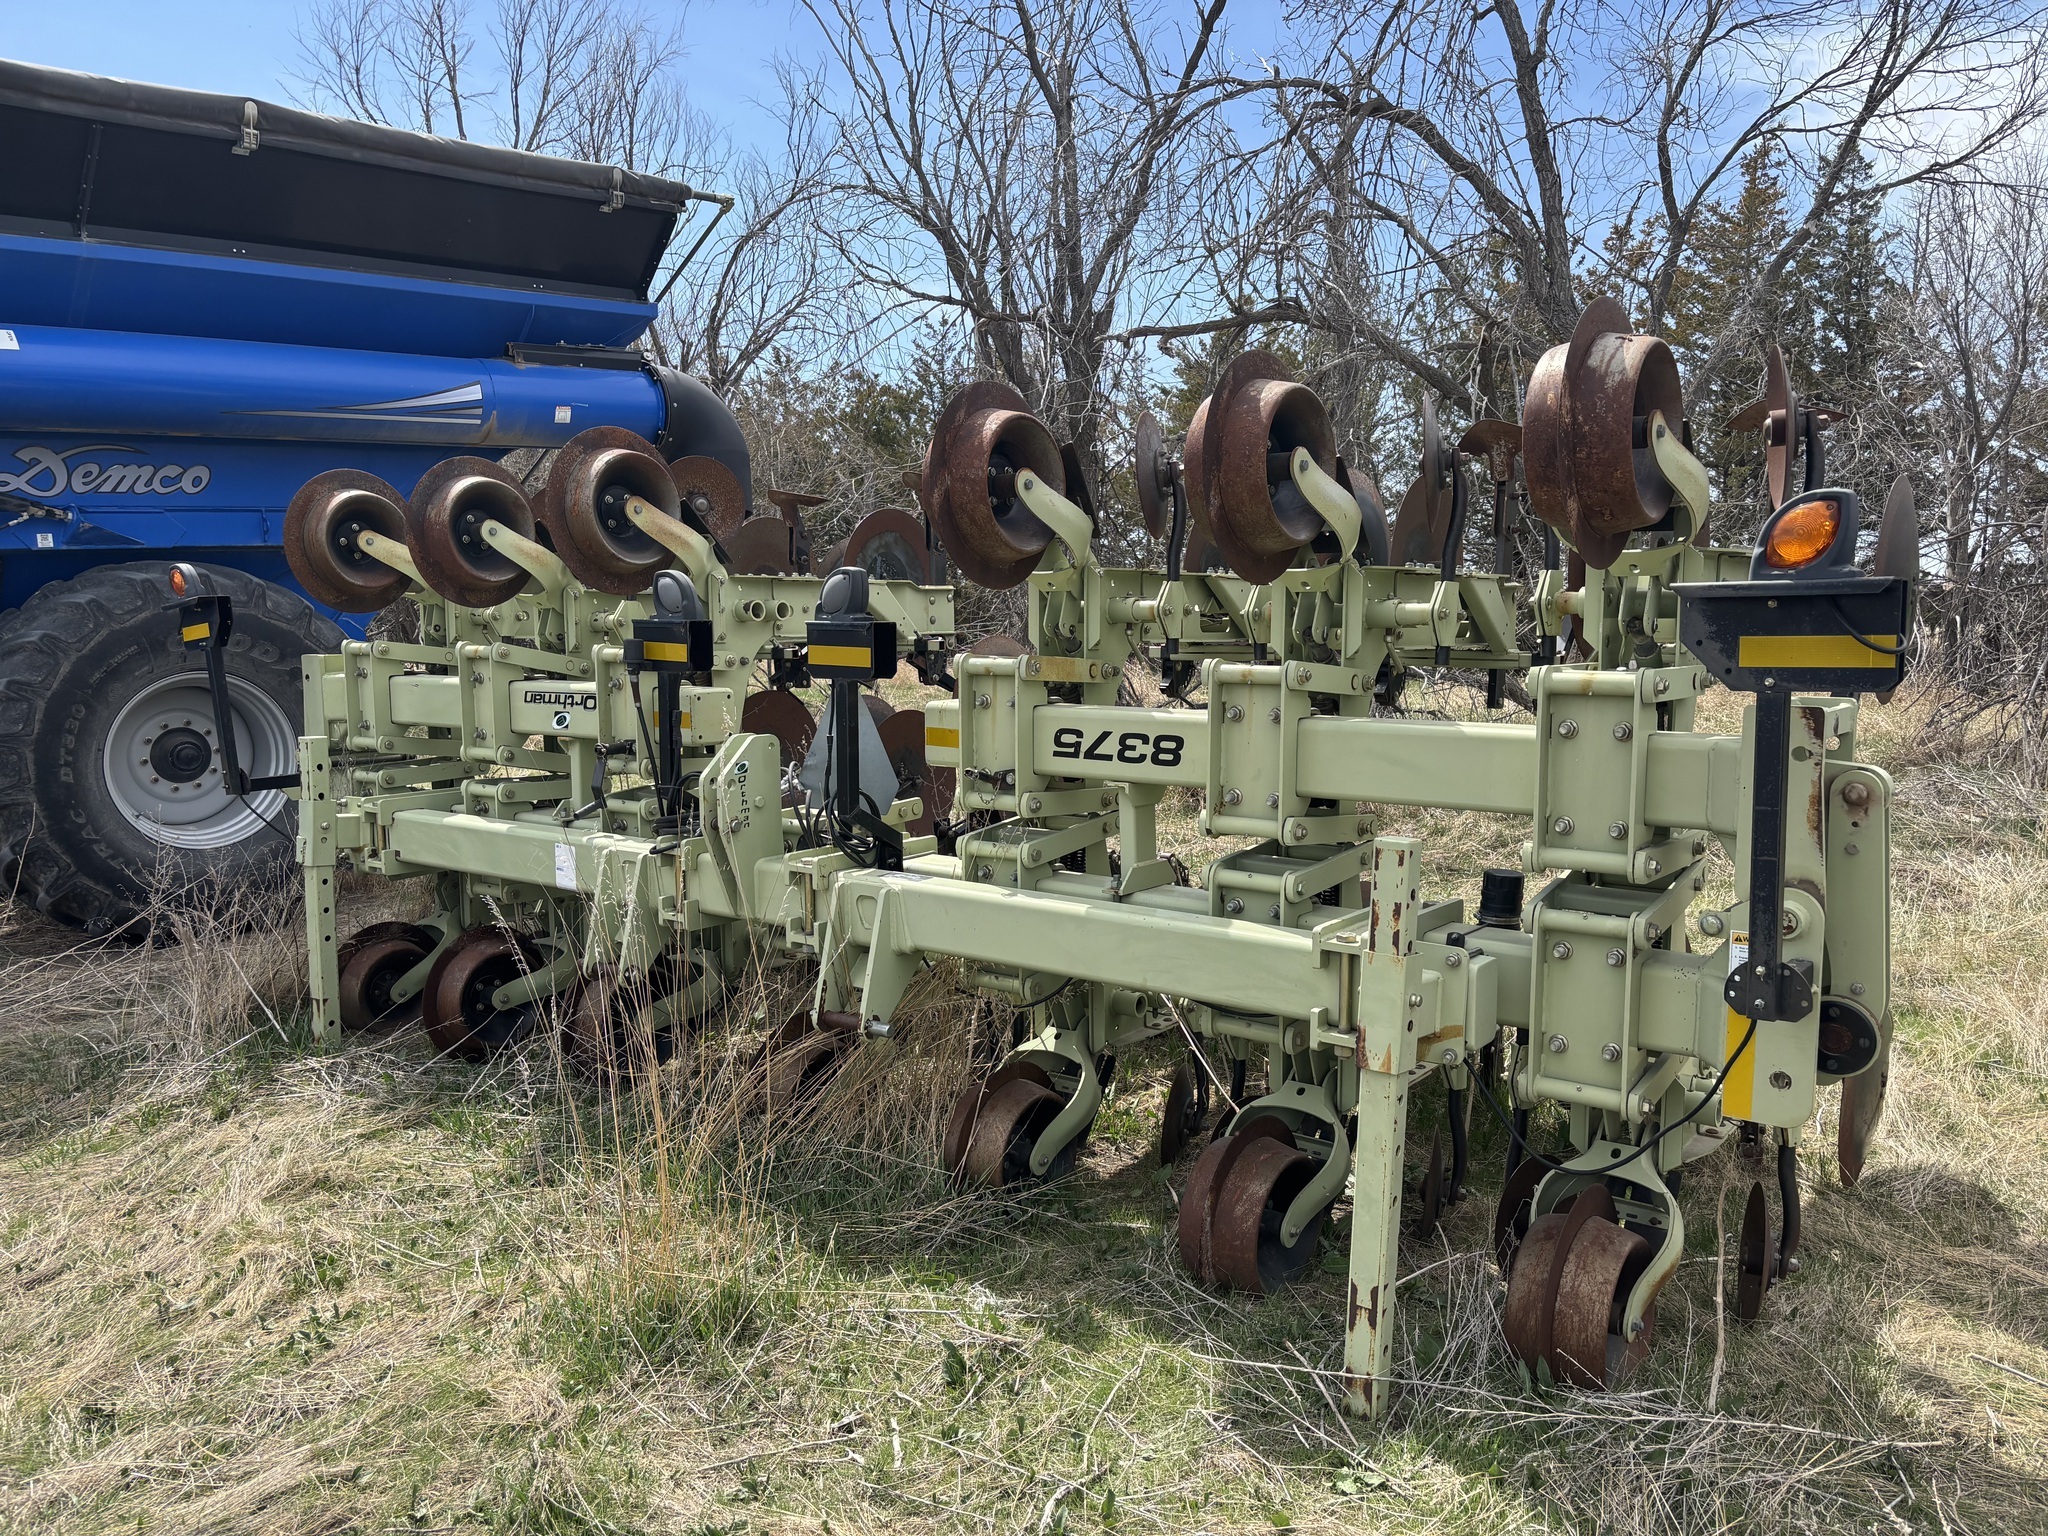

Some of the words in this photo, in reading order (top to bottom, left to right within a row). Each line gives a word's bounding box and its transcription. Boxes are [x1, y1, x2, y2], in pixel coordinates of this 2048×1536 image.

[0, 443, 212, 498] Demco
[524, 690, 597, 711] Orthman
[59, 703, 86, 783] DT830
[1052, 727, 1185, 767] 8375
[737, 775, 750, 828] Orthman
